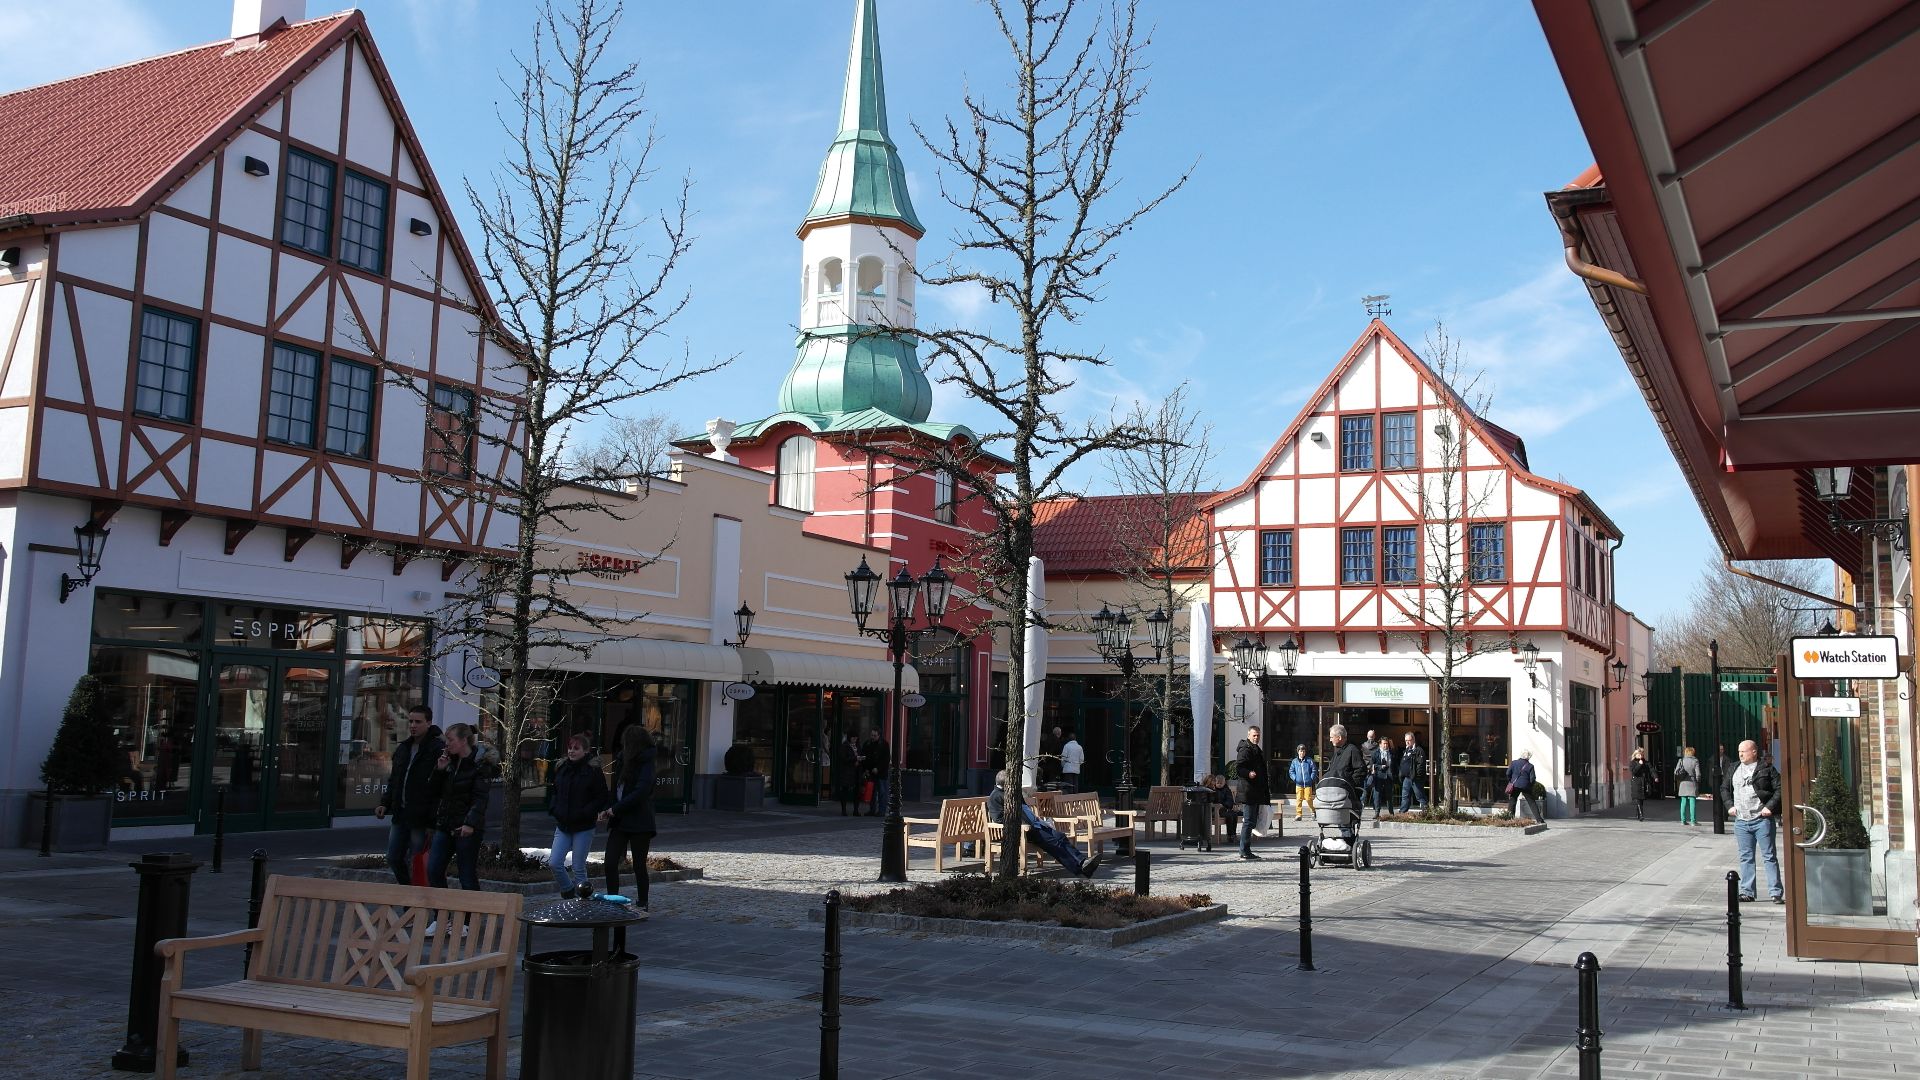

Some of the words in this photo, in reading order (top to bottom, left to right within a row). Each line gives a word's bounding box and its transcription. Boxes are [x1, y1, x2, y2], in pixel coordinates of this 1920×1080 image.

[577, 551, 641, 574] ESPRIT
[233, 619, 310, 640] ESPRI
[1819, 650, 1850, 663] Watch
[1851, 650, 1887, 663] Station
[655, 776, 680, 786] SPRIT
[355, 784, 389, 794] ESPR
